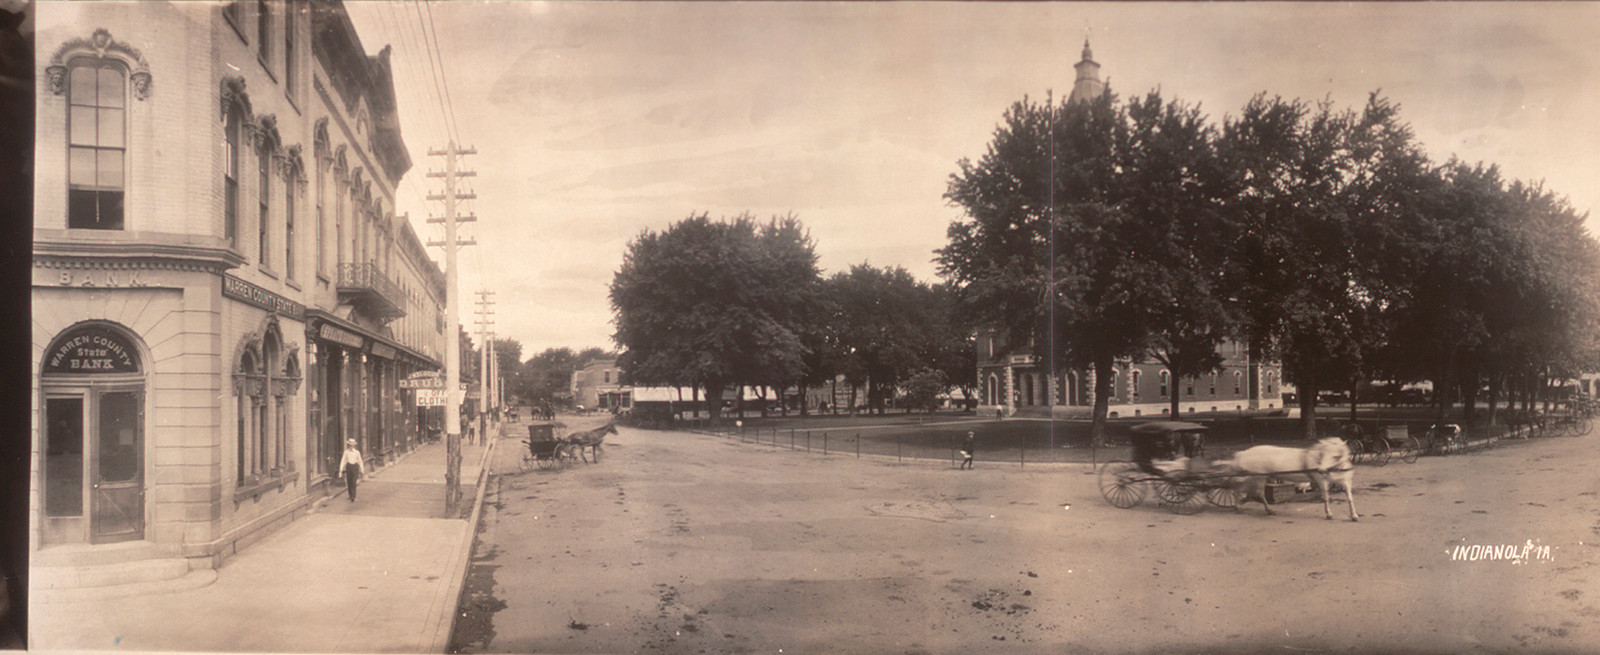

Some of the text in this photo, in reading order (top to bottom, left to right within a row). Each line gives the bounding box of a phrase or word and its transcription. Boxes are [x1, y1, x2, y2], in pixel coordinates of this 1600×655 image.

[60, 270, 141, 287] BANK
[225, 277, 253, 301] WARREN
[253, 286, 276, 309] COUNTY
[276, 297, 293, 314] STATE
[51, 335, 132, 367] WARREN COUNTY
[70, 359, 114, 369] BANK
